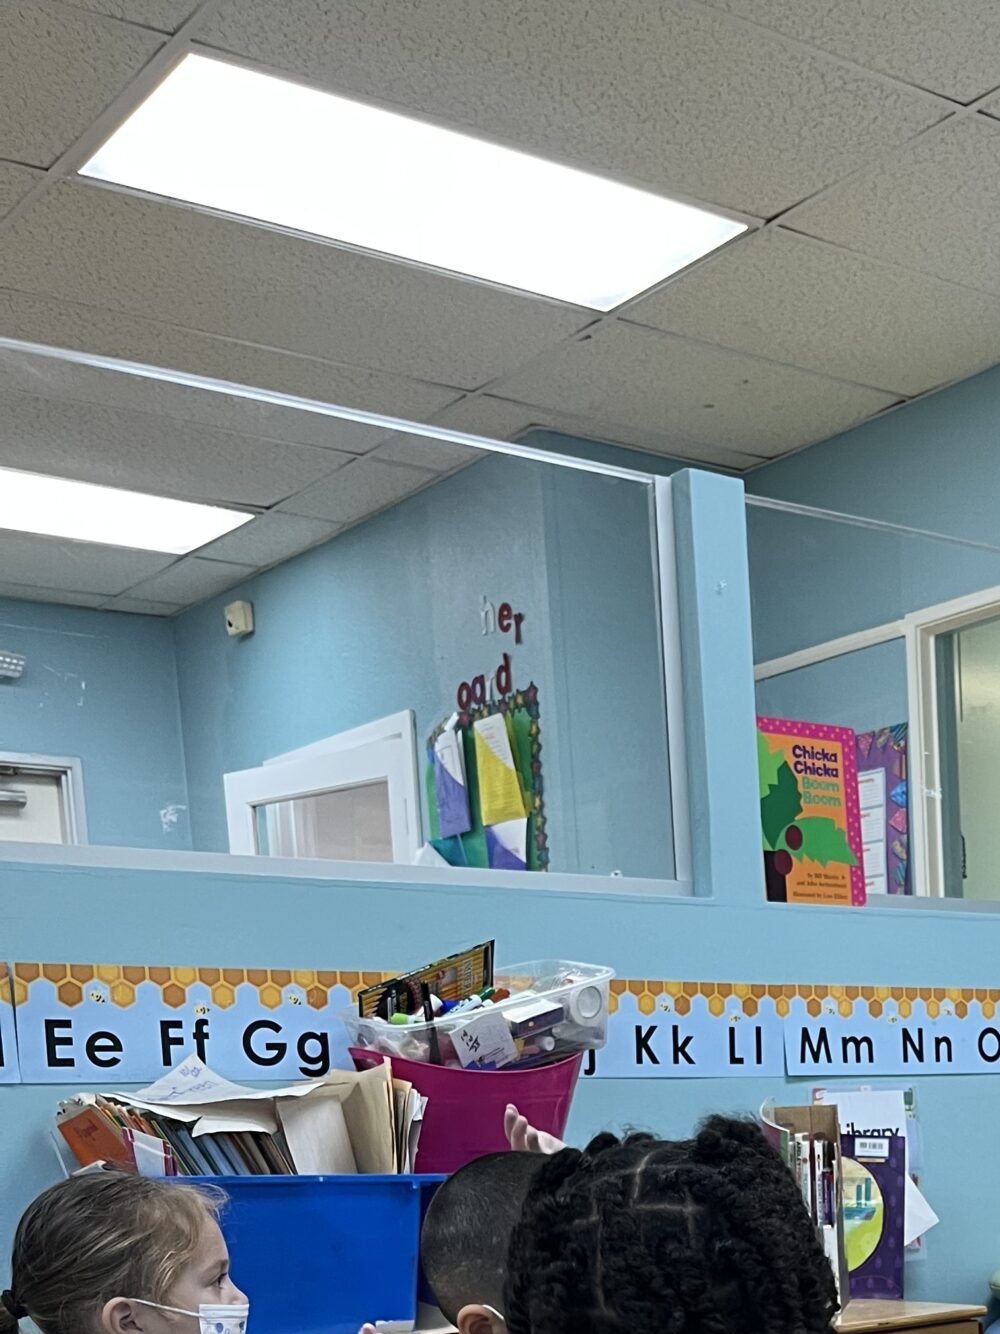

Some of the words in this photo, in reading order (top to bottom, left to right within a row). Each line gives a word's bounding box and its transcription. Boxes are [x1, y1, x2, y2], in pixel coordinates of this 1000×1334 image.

[792, 744, 838, 763] Chicka
[793, 760, 839, 778] Chicka
[802, 775, 840, 792] Boom
[802, 791, 841, 807] Boom
[44, 1018, 124, 1068] Ee
[242, 1019, 330, 1078] Gg
[635, 1024, 696, 1065] Kk
[799, 1027, 874, 1064] Mm
[901, 1027, 953, 1063] Nn
